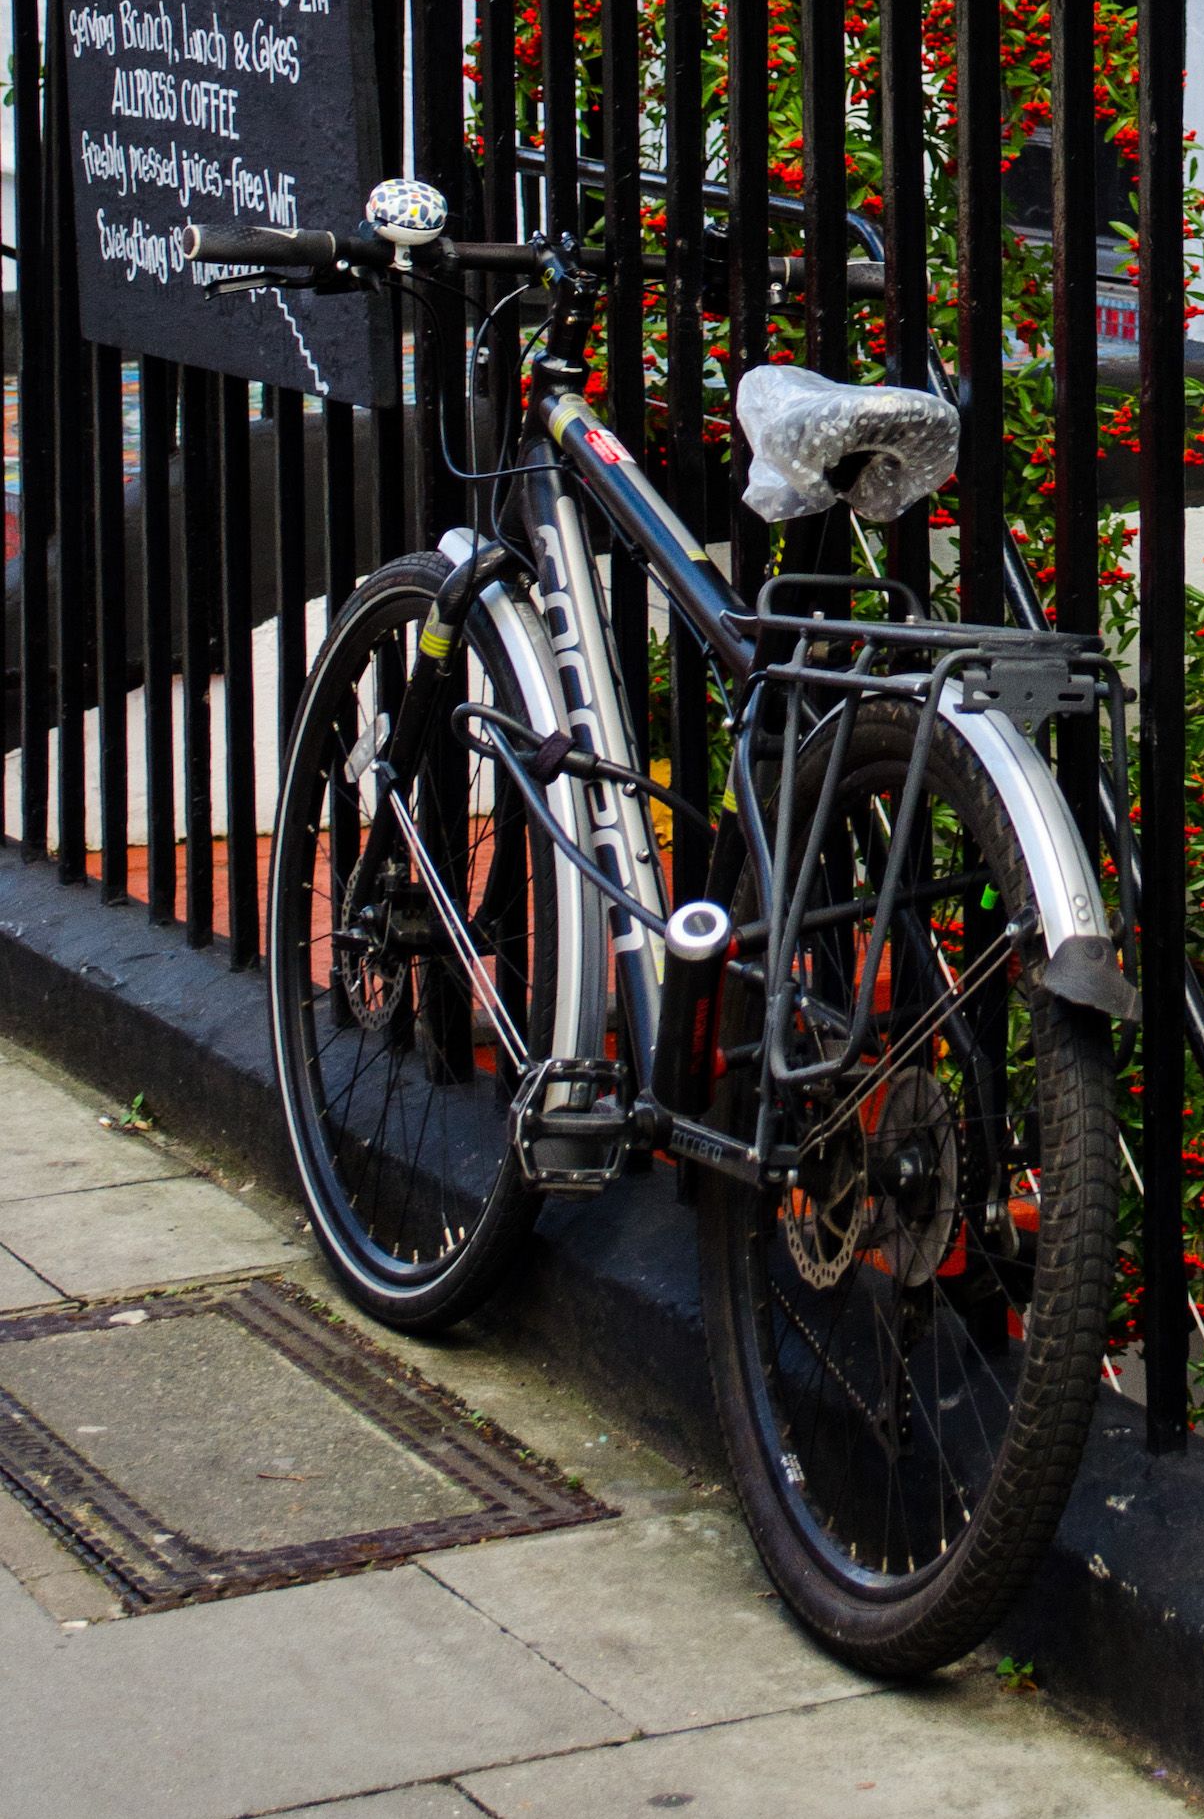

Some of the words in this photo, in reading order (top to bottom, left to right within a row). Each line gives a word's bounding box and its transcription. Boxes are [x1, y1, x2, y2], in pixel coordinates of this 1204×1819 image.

[119, 0, 180, 66] Brunch,
[181, 2, 227, 71] Lunch
[233, 31, 251, 72] &
[252, 18, 300, 84] Cakes
[112, 67, 177, 122] ALLPRESS
[181, 79, 240, 140] COFFEE
[81, 130, 127, 197] freshly
[129, 141, 178, 193] pressed
[97, 208, 169, 284] Everything
[169, 227, 184, 272] is
